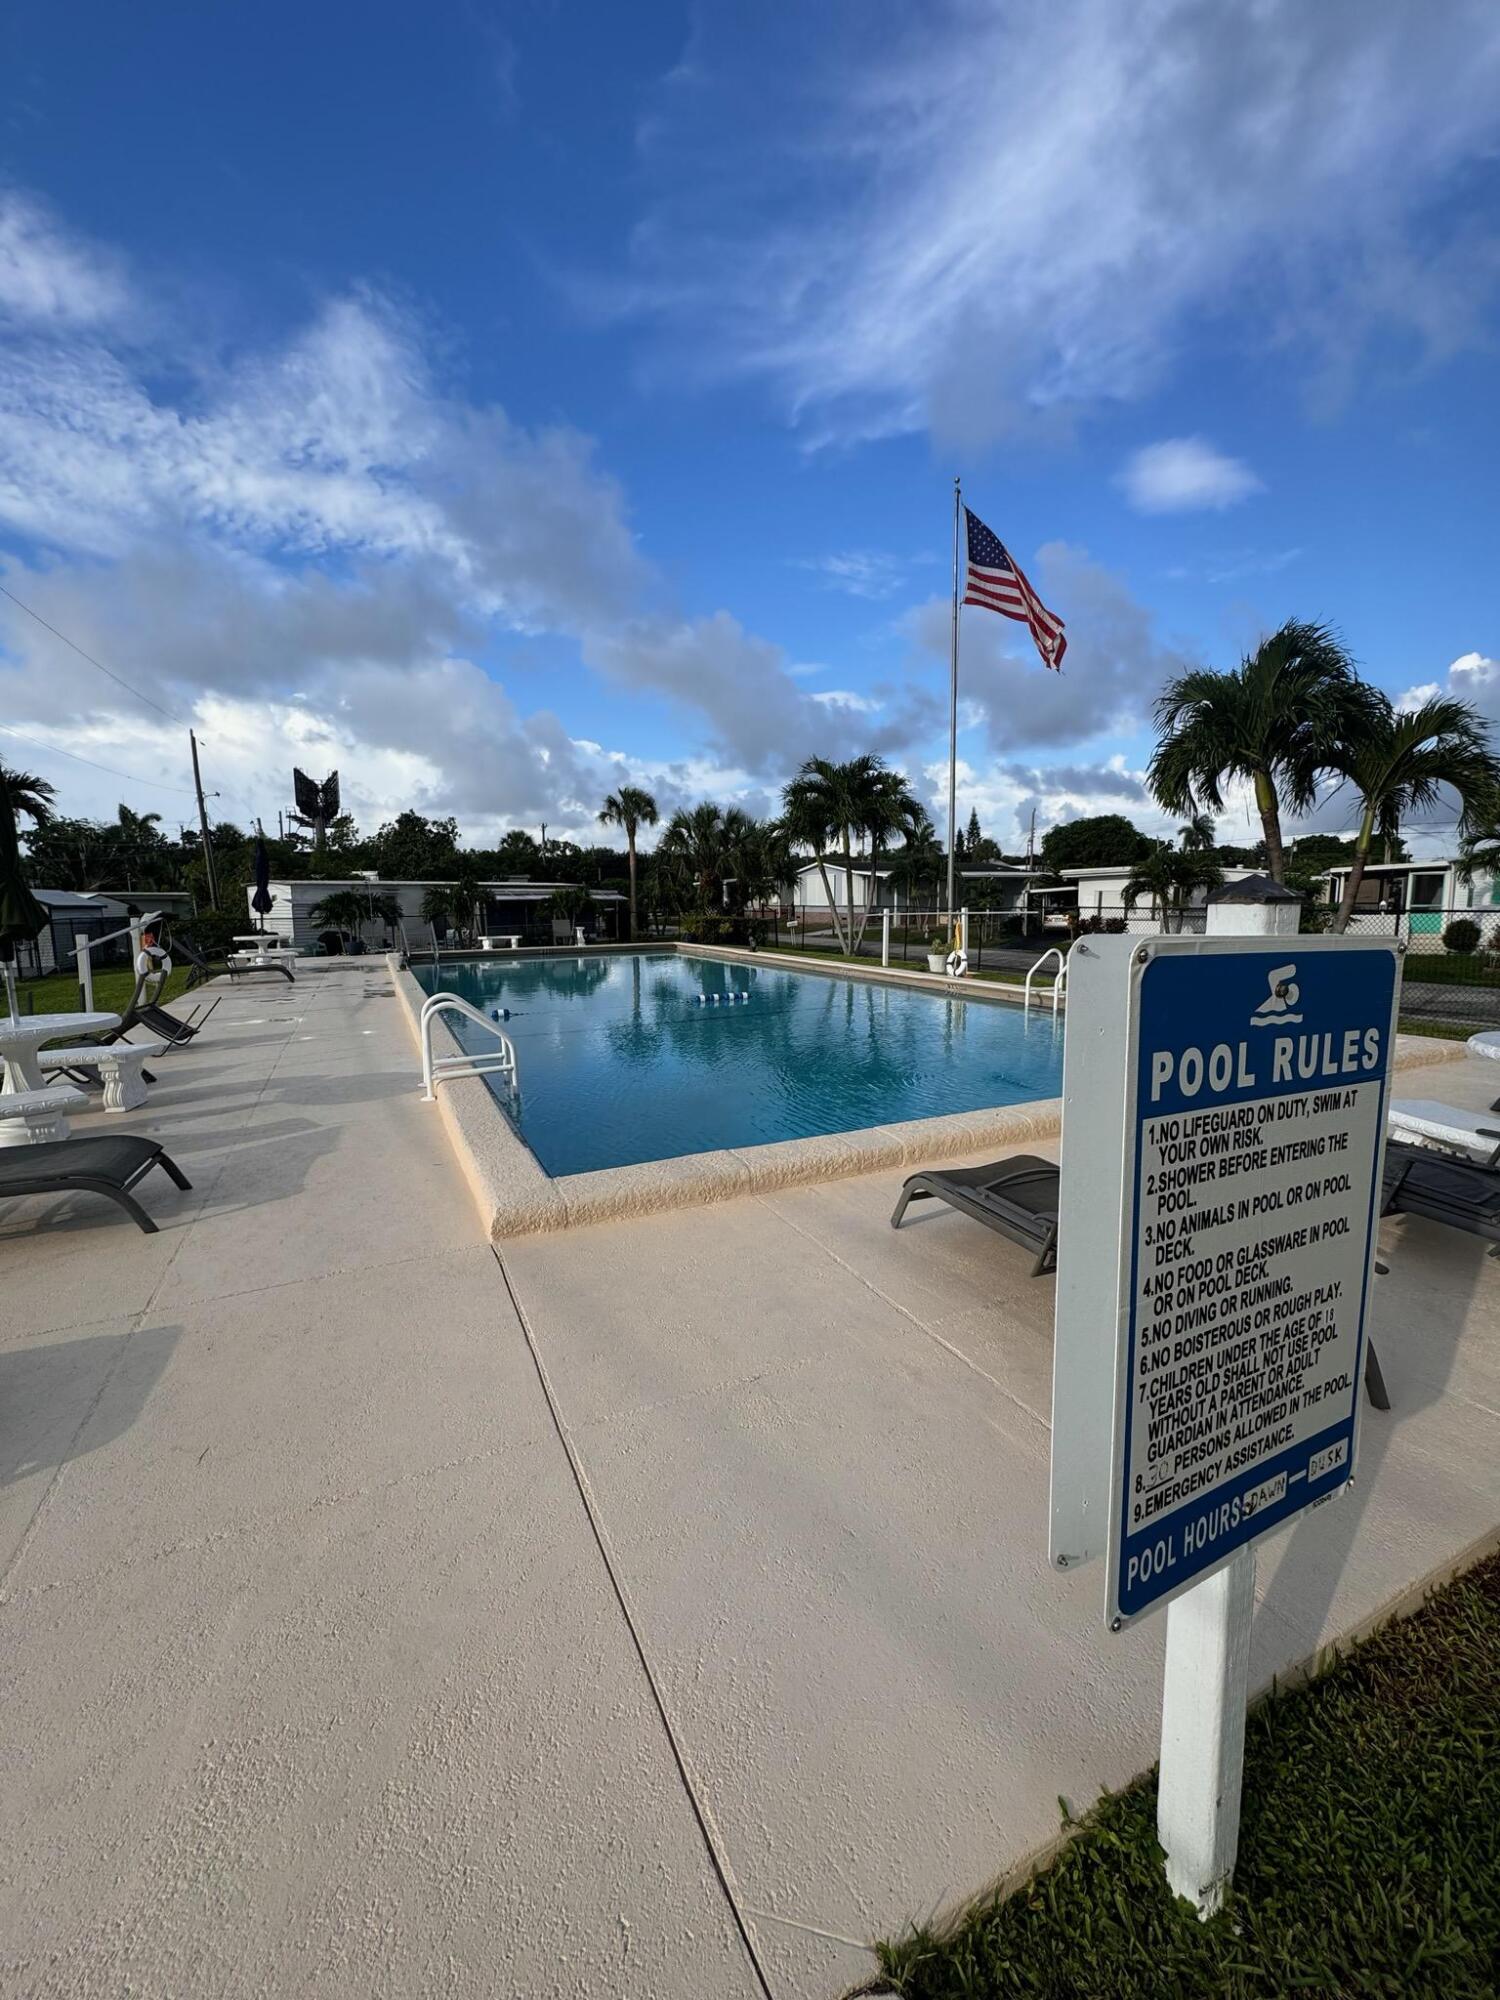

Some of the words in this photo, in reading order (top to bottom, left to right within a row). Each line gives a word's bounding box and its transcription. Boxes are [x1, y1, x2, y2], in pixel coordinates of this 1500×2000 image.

[1151, 1042, 1255, 1101] POOL
[1272, 1028, 1379, 1083] RULES
[1183, 1107, 1254, 1138] LIFEGUARD
[1258, 1103, 1274, 1123] ON
[1278, 1098, 1310, 1121] DUTY,
[1313, 1092, 1340, 1112] SWIM
[1340, 1090, 1357, 1109] AT
[1159, 1141, 1196, 1166] YOUR
[1200, 1136, 1229, 1157] OWN
[1232, 1128, 1263, 1149] RISK.
[1219, 1151, 1266, 1178] BEFORE
[1270, 1139, 1324, 1165] ENTERING
[1328, 1132, 1348, 1154] THE
[1158, 1190, 1196, 1216] POOL.
[1179, 1204, 1235, 1236] ANIMALS
[1238, 1200, 1249, 1219] IN
[1253, 1191, 1283, 1215] POOL
[1287, 1188, 1302, 1208] OR
[1306, 1184, 1320, 1203] ON
[1323, 1174, 1351, 1198] POOL
[1156, 1237, 1194, 1266] DECK.
[1177, 1259, 1212, 1286] FOOD
[1216, 1252, 1233, 1272] OR
[1236, 1230, 1307, 1267] GLASSWARE
[1309, 1228, 1320, 1245] IN
[1322, 1217, 1349, 1239] POOL
[1154, 1293, 1173, 1316] OR
[1176, 1288, 1195, 1309] ON
[1198, 1274, 1231, 1298] POOL
[1235, 1260, 1269, 1287] DECK.
[1175, 1302, 1217, 1334] DIVING
[1221, 1295, 1237, 1317] OR
[1240, 1276, 1293, 1310] RUNNING.
[1174, 1315, 1251, 1361] BOISTEROUS
[1254, 1308, 1271, 1328] OR
[1273, 1293, 1310, 1319] ROUGH
[1314, 1281, 1342, 1306] PLAY.
[1217, 1338, 1257, 1369] UNDER
[1260, 1328, 1281, 1351] THE
[1284, 1318, 1306, 1339] AGE
[1308, 1309, 1322, 1328] OF
[1148, 1404, 1205, 1441] WITHOUT
[1209, 1398, 1217, 1415] A
[1221, 1372, 1264, 1404] PARENT
[1267, 1365, 1284, 1385] OR
[1287, 1348, 1320, 1377] ADULT
[1149, 1385, 1192, 1419] YEARS
[1195, 1373, 1219, 1398] OLD
[1223, 1357, 1259, 1385] SHALL
[1263, 1345, 1285, 1368] NOT
[1287, 1336, 1308, 1358] USE
[1310, 1324, 1338, 1347] POOL
[1148, 1422, 1212, 1461] GUARDIAN
[1216, 1415, 1227, 1431] IN
[1230, 1376, 1305, 1422] ATTENDANCE.
[1174, 1430, 1231, 1474] PERSONS
[1233, 1405, 1287, 1445] ALLOWED
[1289, 1396, 1299, 1415] IN
[1302, 1384, 1321, 1408] THE
[1324, 1373, 1352, 1395] POOL.
[1224, 1424, 1295, 1474] ASSISTANCE.
[1128, 1536, 1176, 1590] POOL
[1250, 1478, 1285, 1510] DAWN
[1311, 1447, 1342, 1477] DUSK
